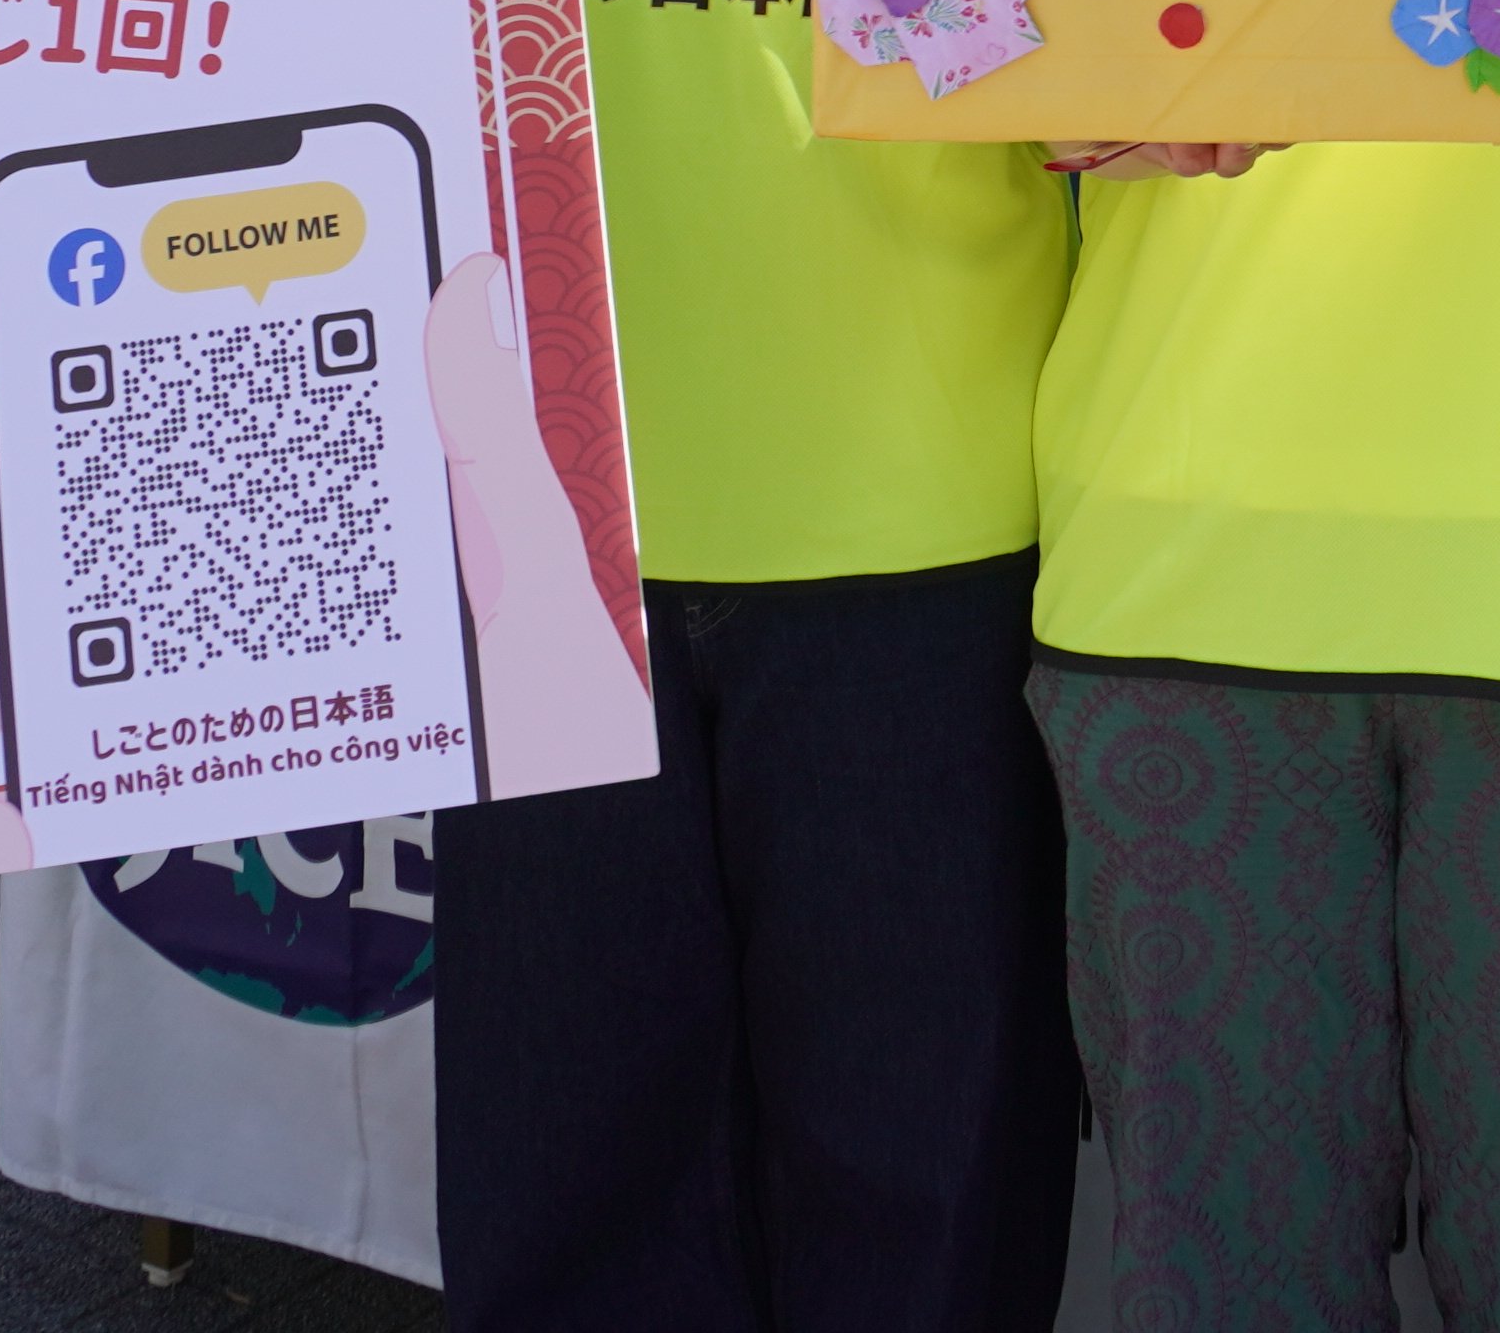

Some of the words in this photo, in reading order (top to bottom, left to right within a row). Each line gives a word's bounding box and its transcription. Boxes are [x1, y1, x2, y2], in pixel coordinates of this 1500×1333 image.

[167, 219, 288, 260] FOLLOW
[297, 213, 341, 242] ME
[92, 684, 394, 760] しごとのための日本語
[25, 773, 107, 808] Tiếng
[116, 764, 184, 796] Nhật
[191, 755, 263, 785] dành
[271, 748, 322, 773] cho
[331, 737, 400, 764] công
[408, 722, 466, 755] việc
